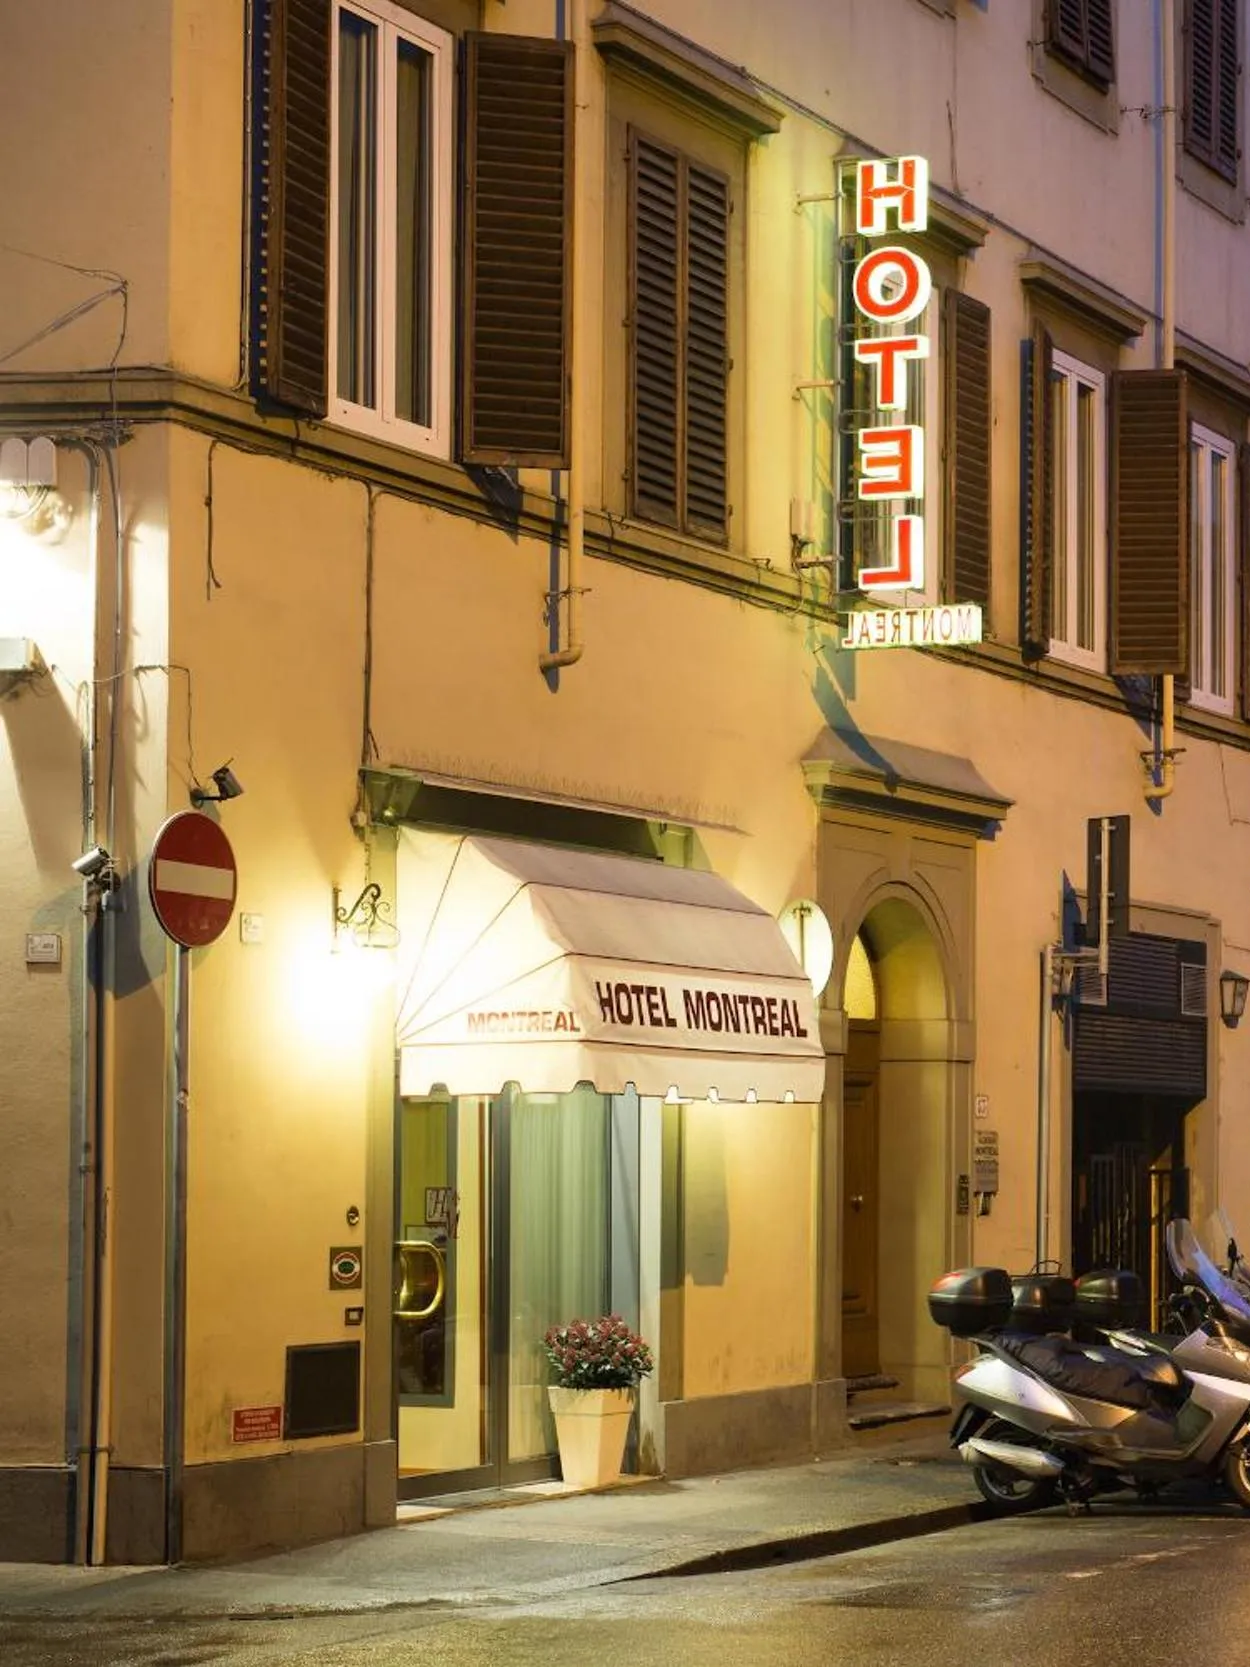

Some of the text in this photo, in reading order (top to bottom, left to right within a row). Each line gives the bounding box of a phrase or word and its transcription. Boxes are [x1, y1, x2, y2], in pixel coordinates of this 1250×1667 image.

[467, 1011, 580, 1033] MONTREAL
[595, 981, 808, 1037] HOTEL MONTREAL
